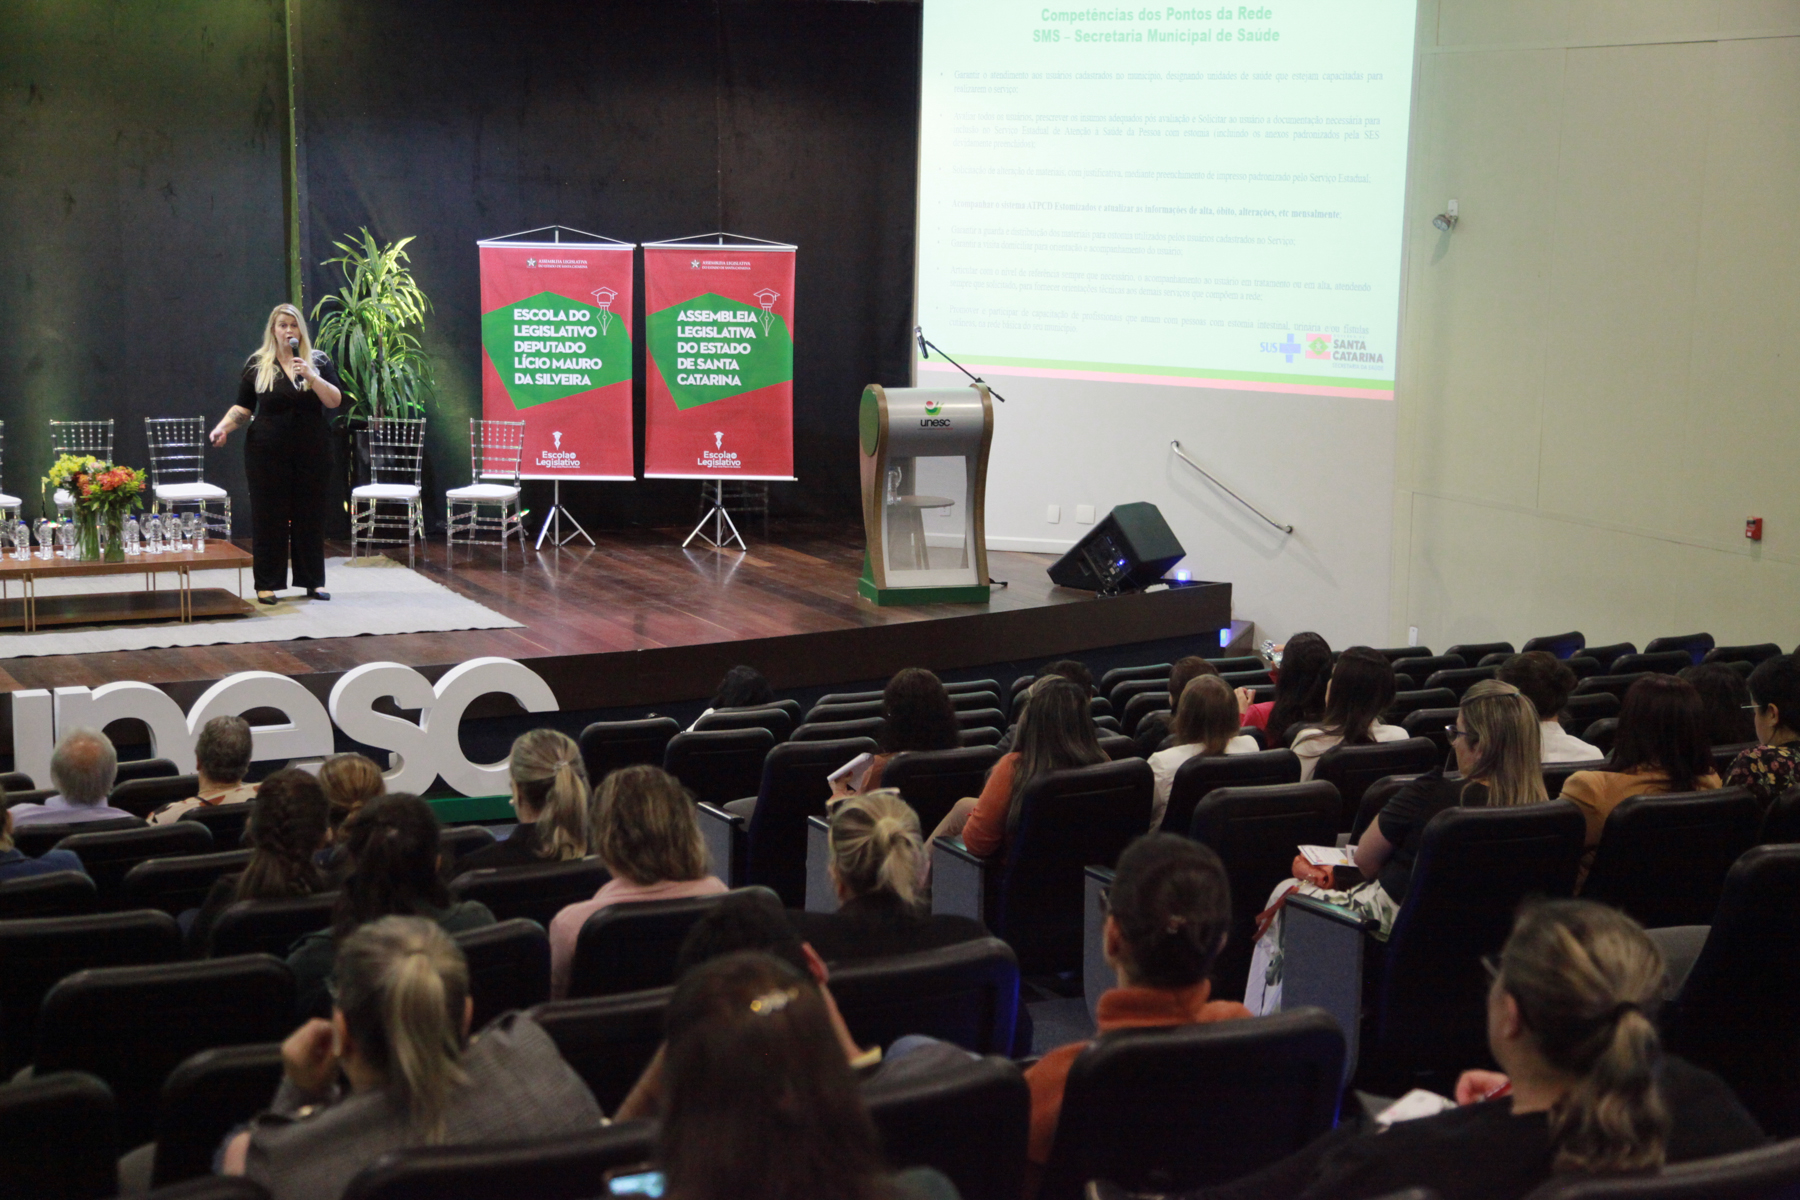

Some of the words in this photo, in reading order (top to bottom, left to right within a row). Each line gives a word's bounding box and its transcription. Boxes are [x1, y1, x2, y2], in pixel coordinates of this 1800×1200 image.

[1041, 7, 1134, 25] Competências
[1138, 8, 1162, 21] dos
[1166, 7, 1212, 21] Pontos
[1217, 7, 1233, 20] da
[1237, 6, 1273, 20] Rede
[1032, 29, 1061, 43] SMS
[1074, 29, 1142, 43] Secretaria
[1147, 28, 1212, 46] Municipal
[1216, 28, 1233, 42] de
[1237, 27, 1280, 42] Saúde
[1240, 71, 1249, 80] de
[1126, 127, 1135, 136] da
[1206, 171, 1215, 180] de
[1189, 205, 1198, 214] de
[1241, 279, 1252, 287] em
[1292, 281, 1302, 289] ou
[514, 309, 567, 321] ESCOLA
[570, 309, 590, 321] DO
[677, 309, 758, 322] ASSEMBLEIA
[514, 325, 597, 337] LEGISLATIVO
[677, 326, 757, 338] LEGISLATIVA
[514, 341, 586, 353] DEPUTADO
[677, 342, 698, 354] DO
[699, 342, 751, 354] ESTADO
[1260, 341, 1278, 353] SUS
[1333, 339, 1367, 351] SANTA
[514, 354, 551, 369] LÍCIO
[552, 357, 602, 370] MAURO
[1332, 351, 1384, 364] CATARINA
[677, 358, 695, 370] DE
[697, 358, 739, 370] SANTA
[514, 373, 533, 385] DA
[535, 373, 591, 386] SILVEIRA
[677, 374, 742, 386] CATARINA
[920, 419, 951, 427] unesc
[542, 450, 570, 459] Escola
[703, 450, 731, 459] Escola
[535, 457, 581, 468] Legislativo
[697, 457, 742, 468] Legislativo
